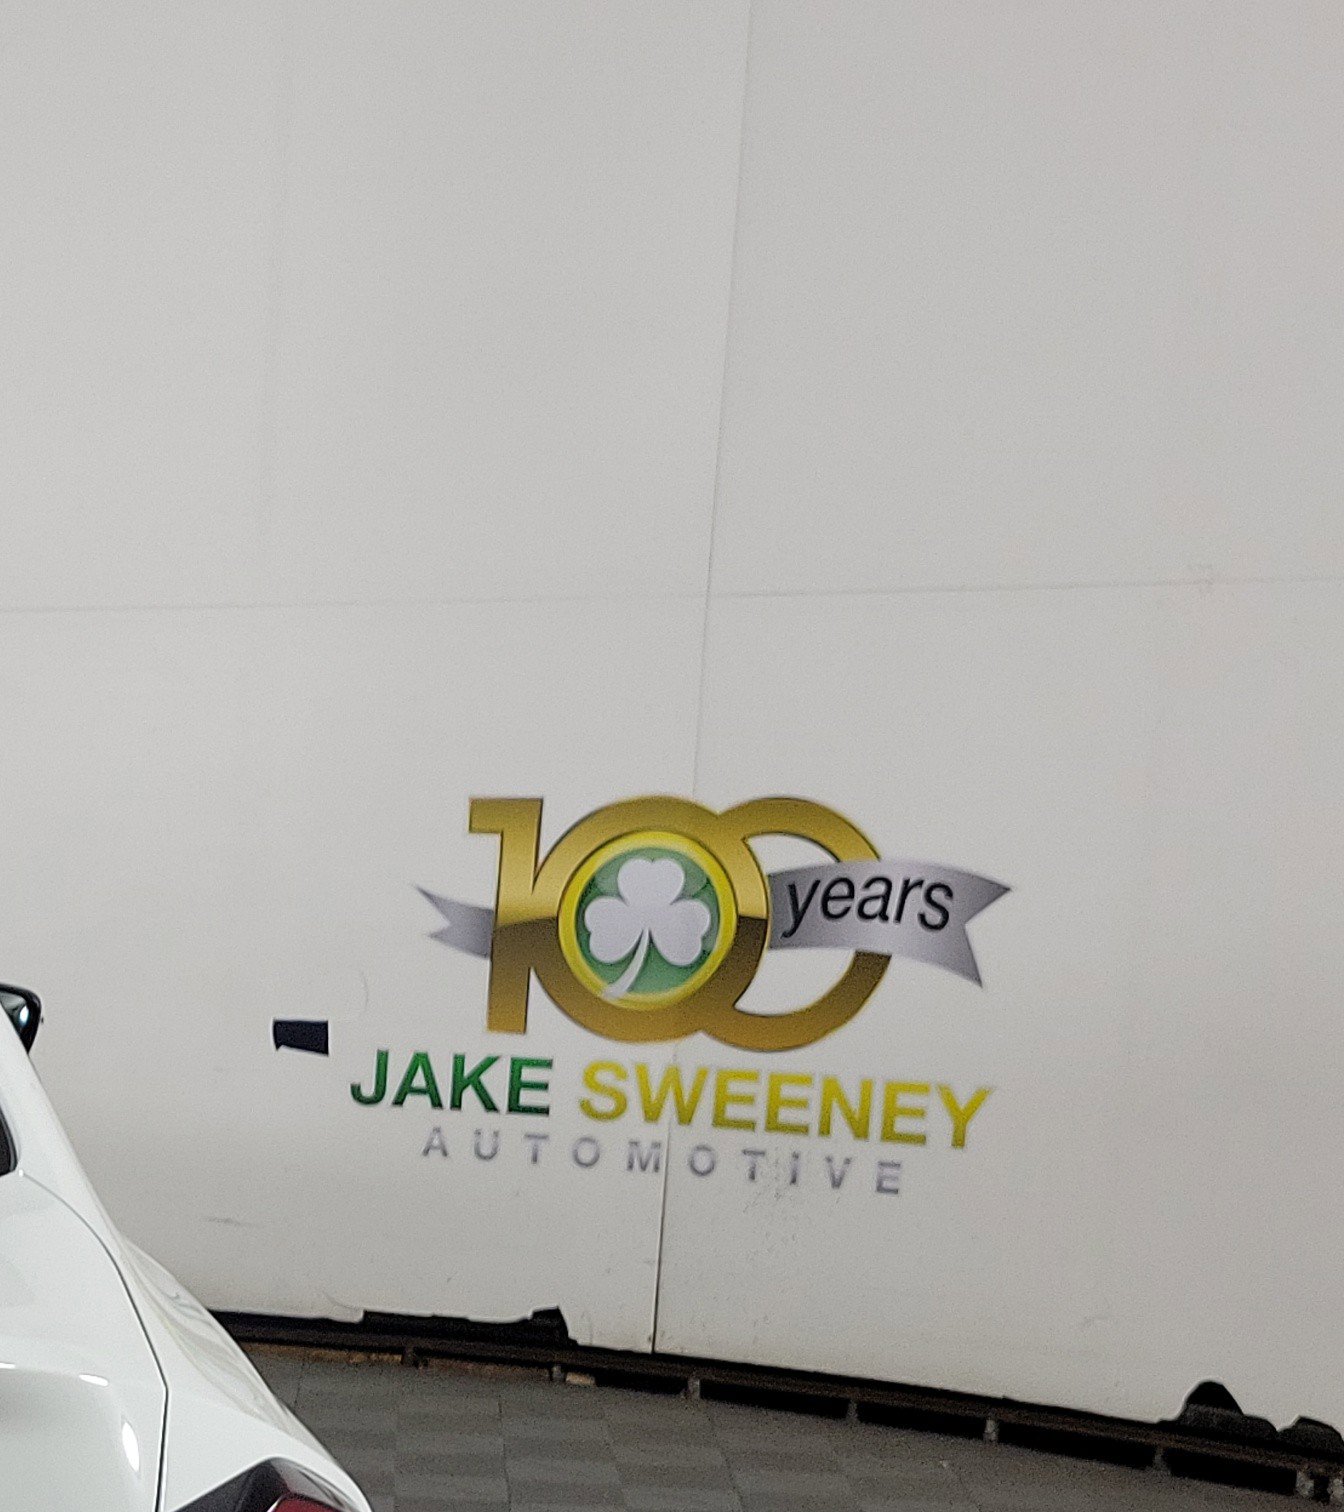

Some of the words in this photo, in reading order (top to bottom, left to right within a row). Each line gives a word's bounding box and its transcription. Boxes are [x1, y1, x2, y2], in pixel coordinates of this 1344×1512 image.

[469, 795, 893, 1053] 100
[781, 871, 954, 938] years
[350, 1049, 554, 1118] JAKE
[578, 1060, 995, 1151] SWEENEY
[422, 1126, 904, 1196] AUTOMOTIVE
